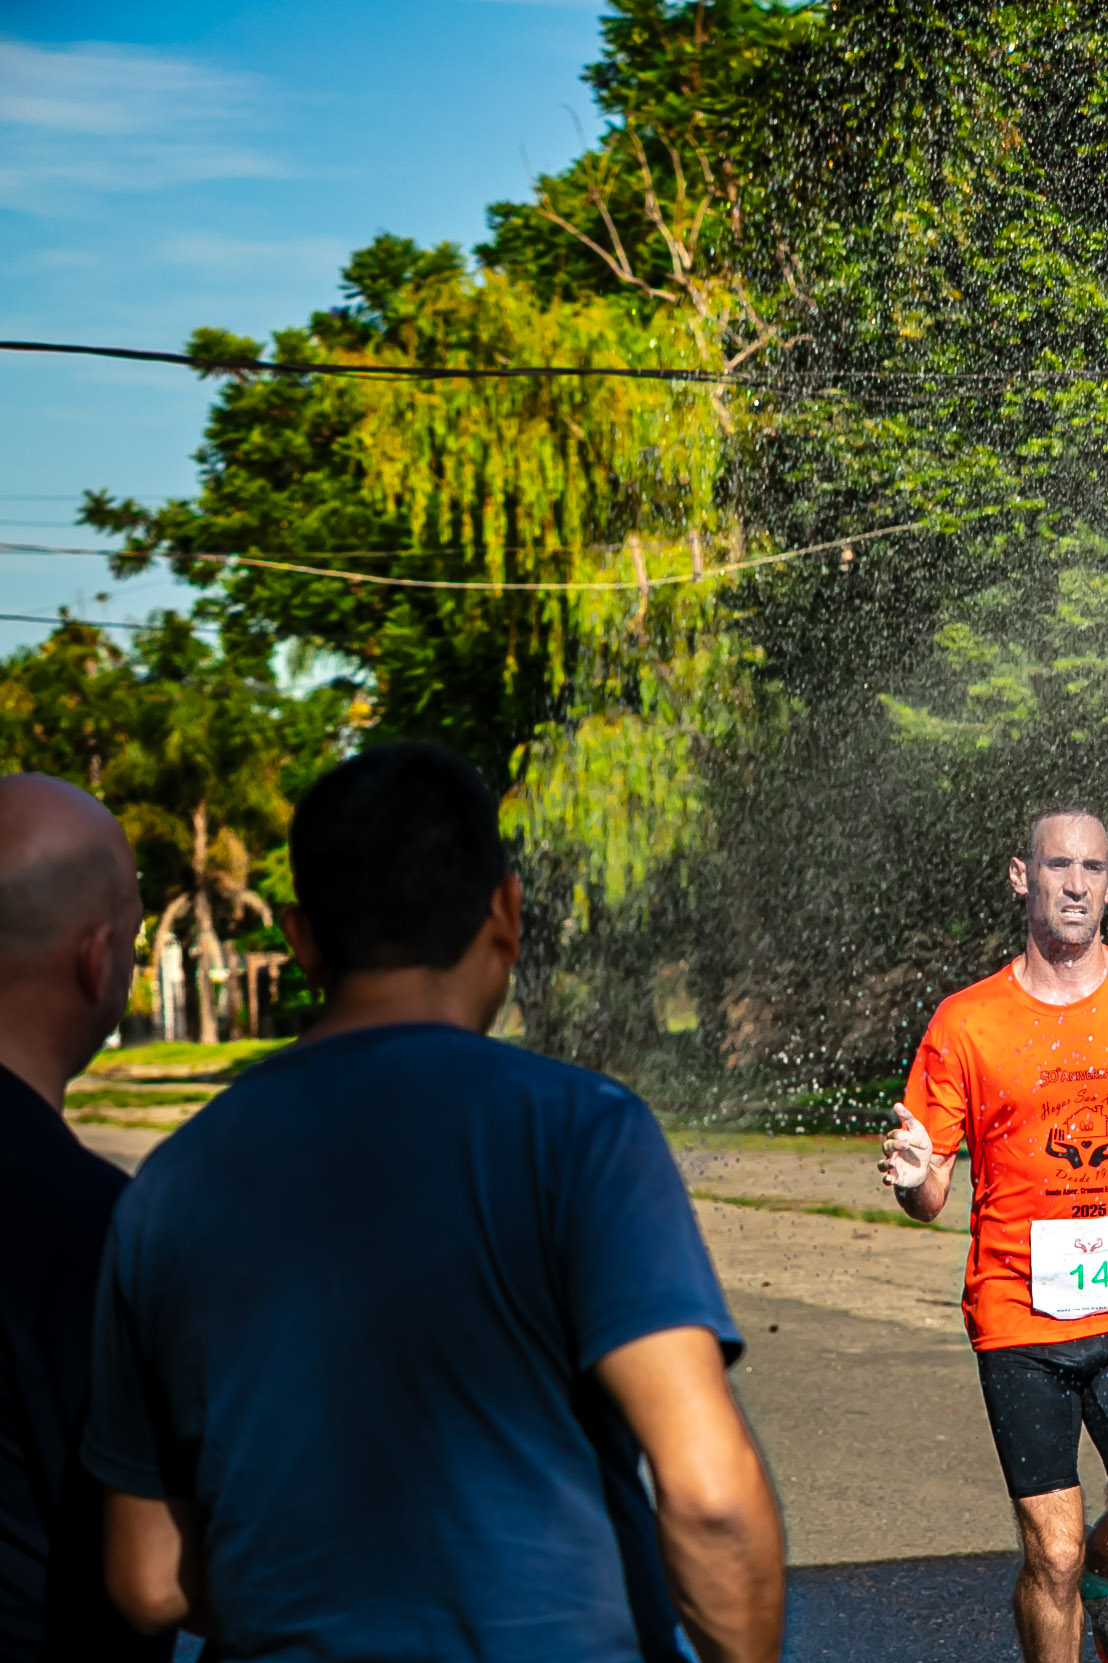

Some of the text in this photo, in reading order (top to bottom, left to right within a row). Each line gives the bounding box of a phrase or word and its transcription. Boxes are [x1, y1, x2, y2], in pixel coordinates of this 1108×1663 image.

[1041, 1099, 1071, 1121] Hogar
[1074, 1088, 1098, 1103] San
[1056, 1169, 1090, 1183] Desde
[1072, 1204, 1107, 1217] 2025
